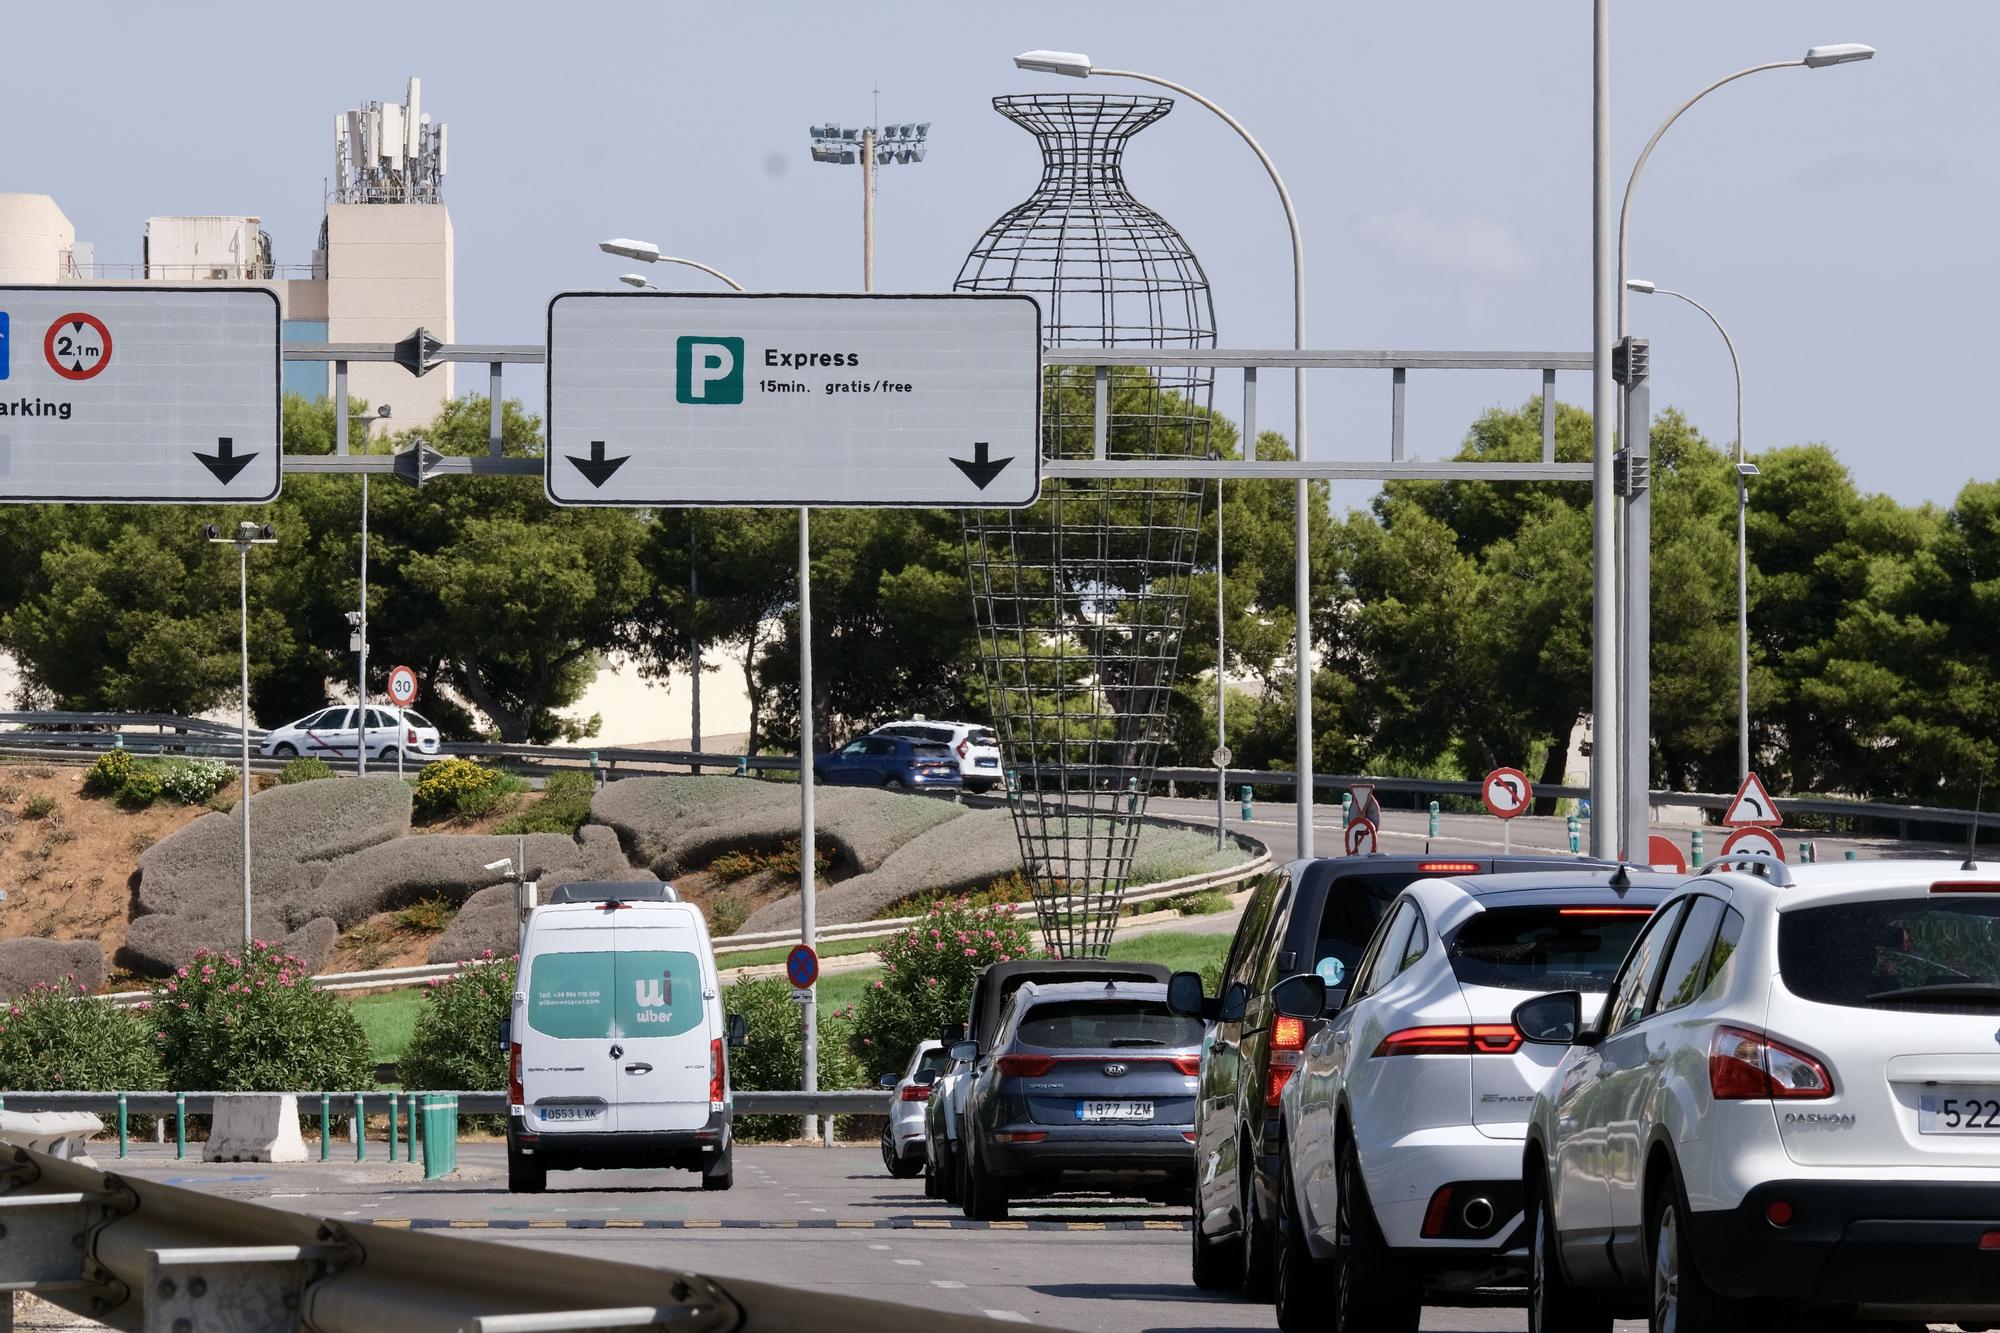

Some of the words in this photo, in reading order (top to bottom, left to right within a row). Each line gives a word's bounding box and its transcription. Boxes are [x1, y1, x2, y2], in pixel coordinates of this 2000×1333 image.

[765, 349, 859, 369] Express
[691, 343, 734, 398] P
[759, 380, 811, 393] 15min.
[825, 380, 913, 395] gratis/free
[0, 398, 72, 420] arking
[395, 680, 410, 693] 30
[636, 1010, 673, 1023] wiber
[548, 1109, 575, 1119] 0553
[577, 1109, 597, 1118] LXK
[1088, 1103, 1120, 1115] 1877
[1126, 1103, 1151, 1115] JZM
[1944, 1099, 2000, 1129] 522
